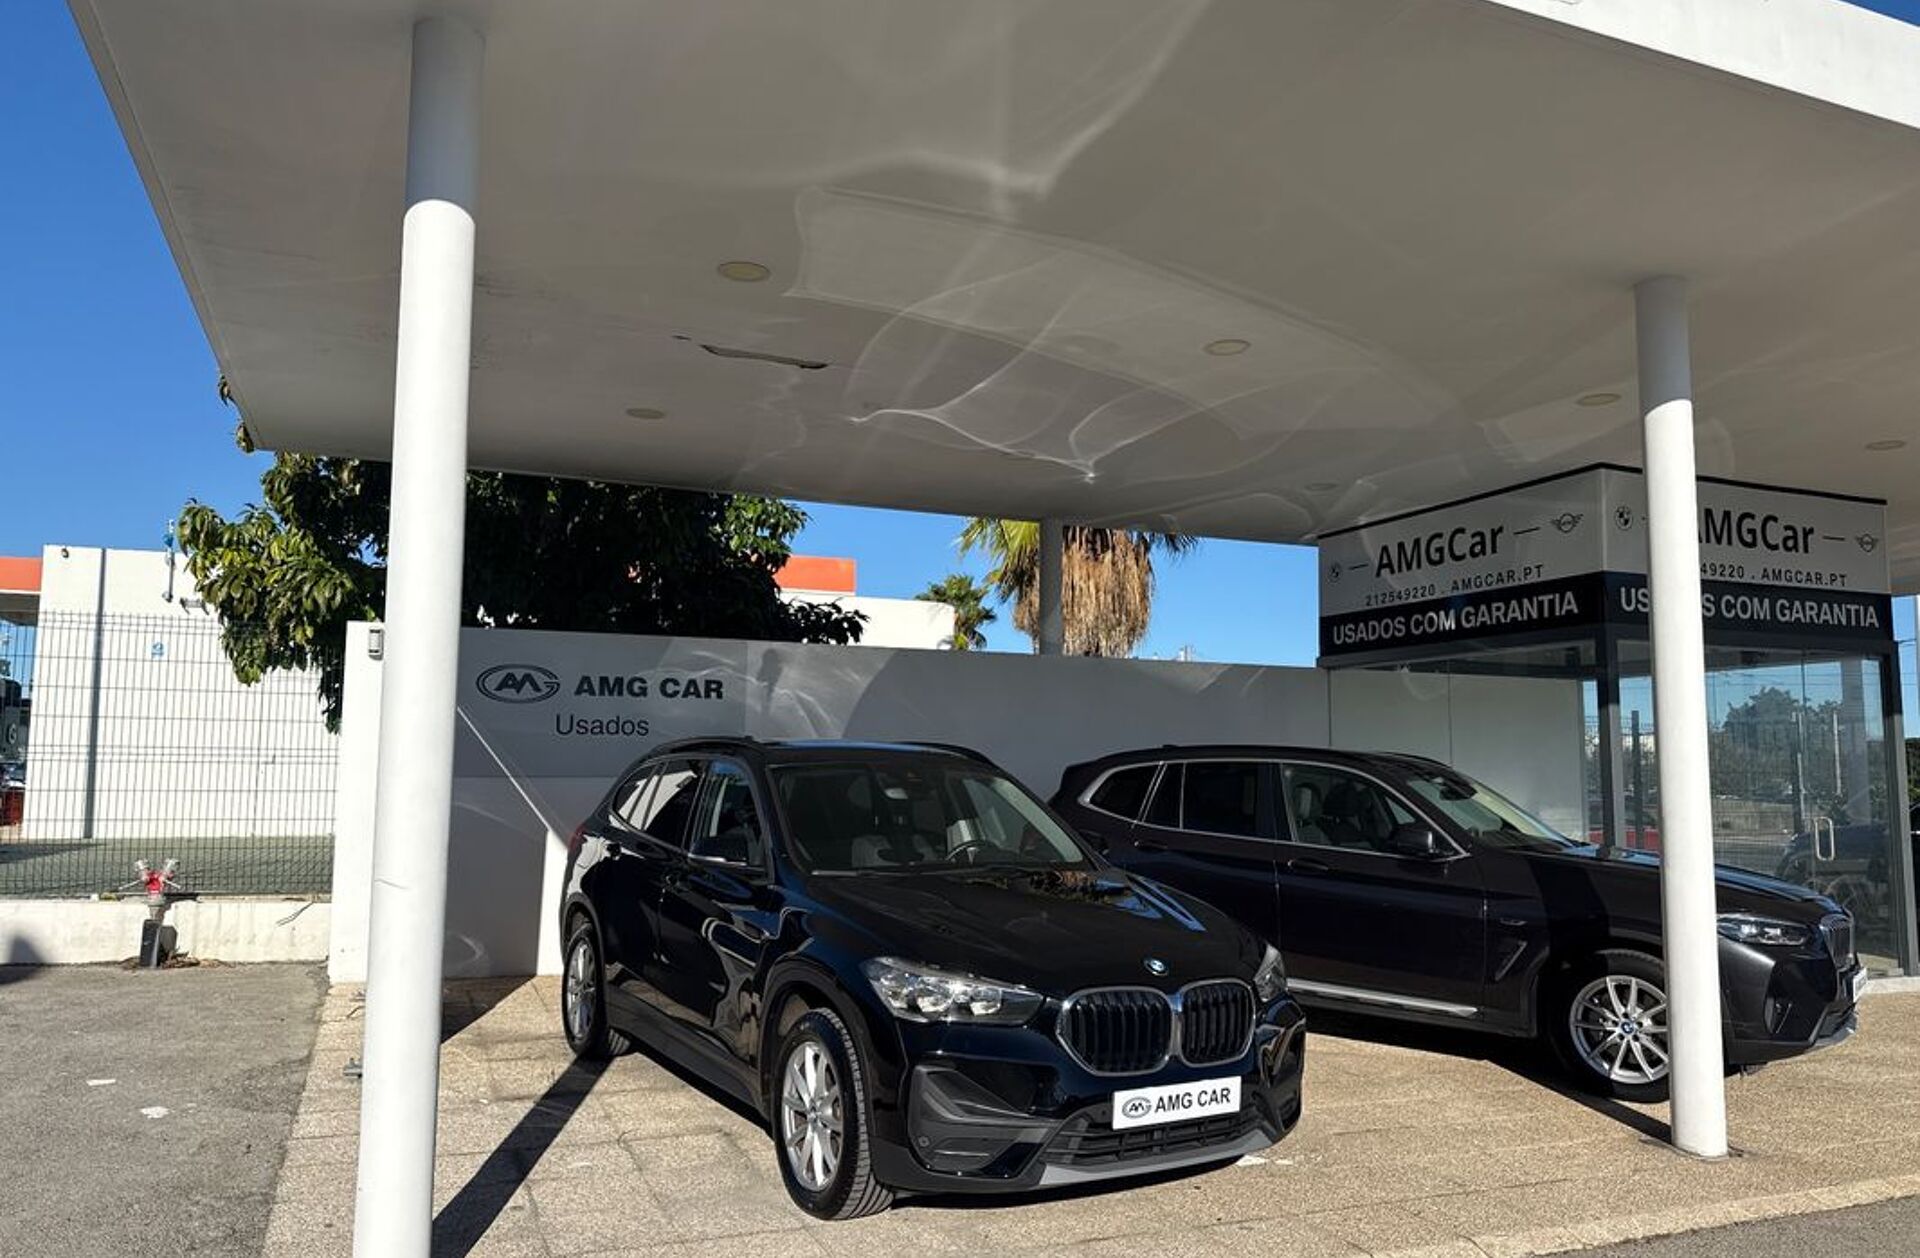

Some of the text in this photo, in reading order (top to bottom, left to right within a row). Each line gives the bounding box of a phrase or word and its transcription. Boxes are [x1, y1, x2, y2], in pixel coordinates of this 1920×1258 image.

[1698, 508, 1814, 554] MGCar
[1375, 525, 1505, 578] AMGCar
[1365, 564, 1545, 607] 212549220 AMGCAR.PT
[1761, 567, 1848, 587] AMGCAR.PT
[1333, 590, 1579, 645] USADOS COM GARANTIA
[1721, 595, 1771, 621] COM
[1775, 597, 1879, 628] GARANTIA
[573, 675, 649, 697] AMG
[659, 678, 724, 699] CAR
[555, 713, 650, 737] Usados
[1154, 1092, 1193, 1113] AMG
[1197, 1087, 1231, 1107] CAR
